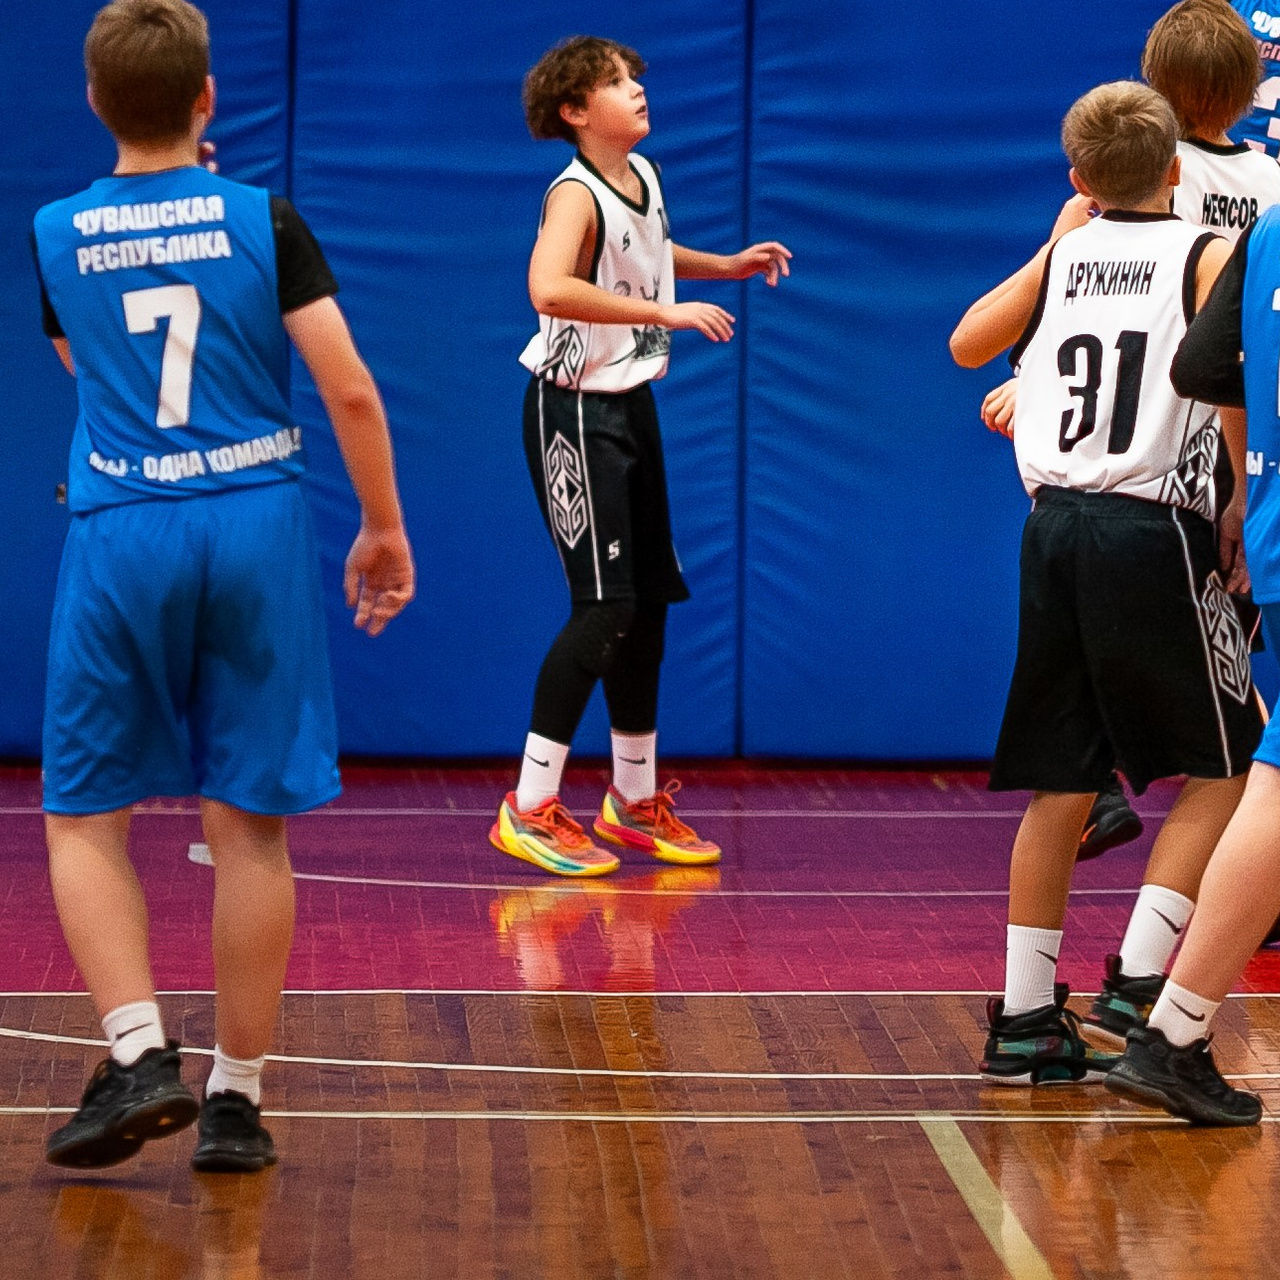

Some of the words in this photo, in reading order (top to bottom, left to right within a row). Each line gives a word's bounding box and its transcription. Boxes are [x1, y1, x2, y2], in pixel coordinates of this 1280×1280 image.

[73, 195, 225, 237] ЧУВАШСКАЯ
[77, 229, 232, 276] РЕСПУБЛИКА
[1064, 261, 1157, 306] ДРУЖИНИН
[122, 284, 200, 429] 7
[1057, 330, 1149, 455] 31
[142, 450, 206, 482] ОДНА
